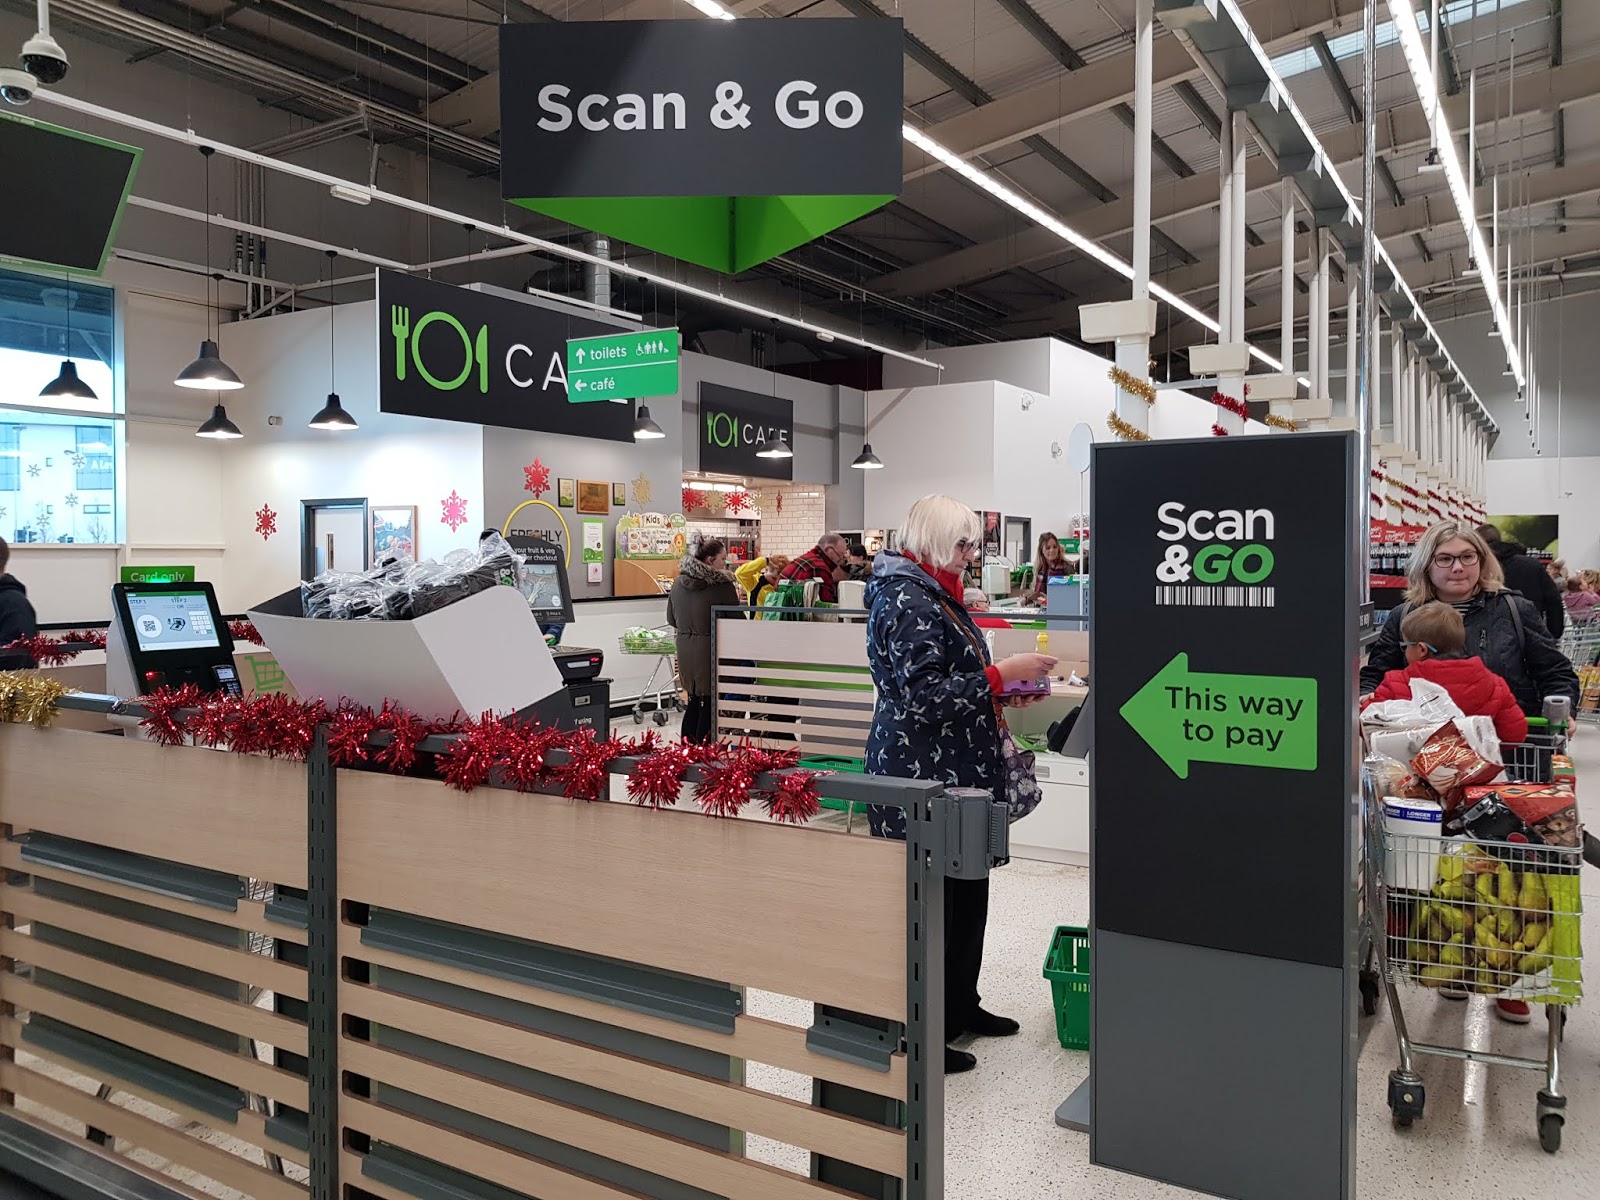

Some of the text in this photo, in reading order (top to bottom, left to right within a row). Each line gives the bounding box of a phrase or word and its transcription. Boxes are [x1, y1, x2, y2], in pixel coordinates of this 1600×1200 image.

[535, 79, 864, 133] Scan & Go
[590, 346, 627, 360] toilets
[590, 376, 616, 391] café
[645, 515, 661, 524] Kids
[1156, 501, 1275, 541] Scan
[527, 546, 539, 554] fruit
[1155, 543, 1275, 584] &GO
[130, 572, 186, 582] Card only
[1164, 685, 1304, 721] This way
[1182, 718, 1284, 752] to pay
